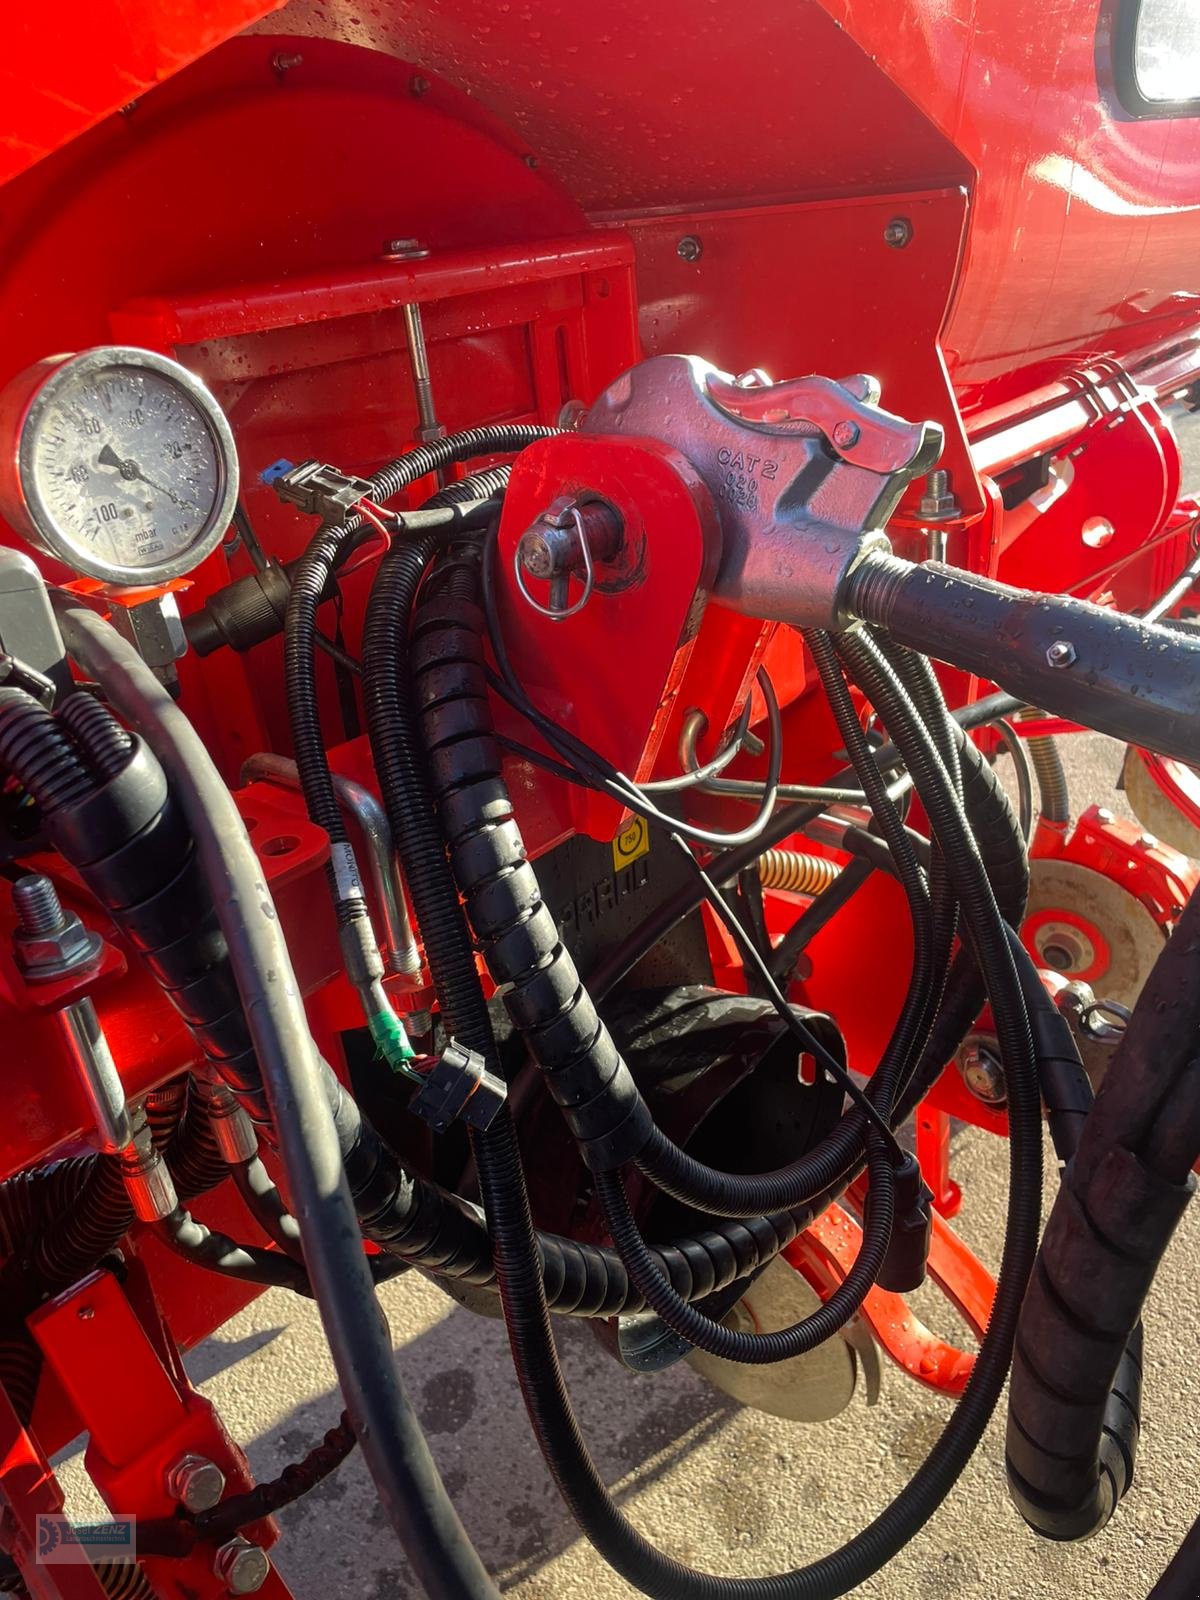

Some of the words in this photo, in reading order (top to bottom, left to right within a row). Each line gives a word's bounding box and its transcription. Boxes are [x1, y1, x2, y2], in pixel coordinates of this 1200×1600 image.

[718, 447, 761, 473] CAT
[761, 460, 779, 480] 2
[135, 527, 157, 542] mbar
